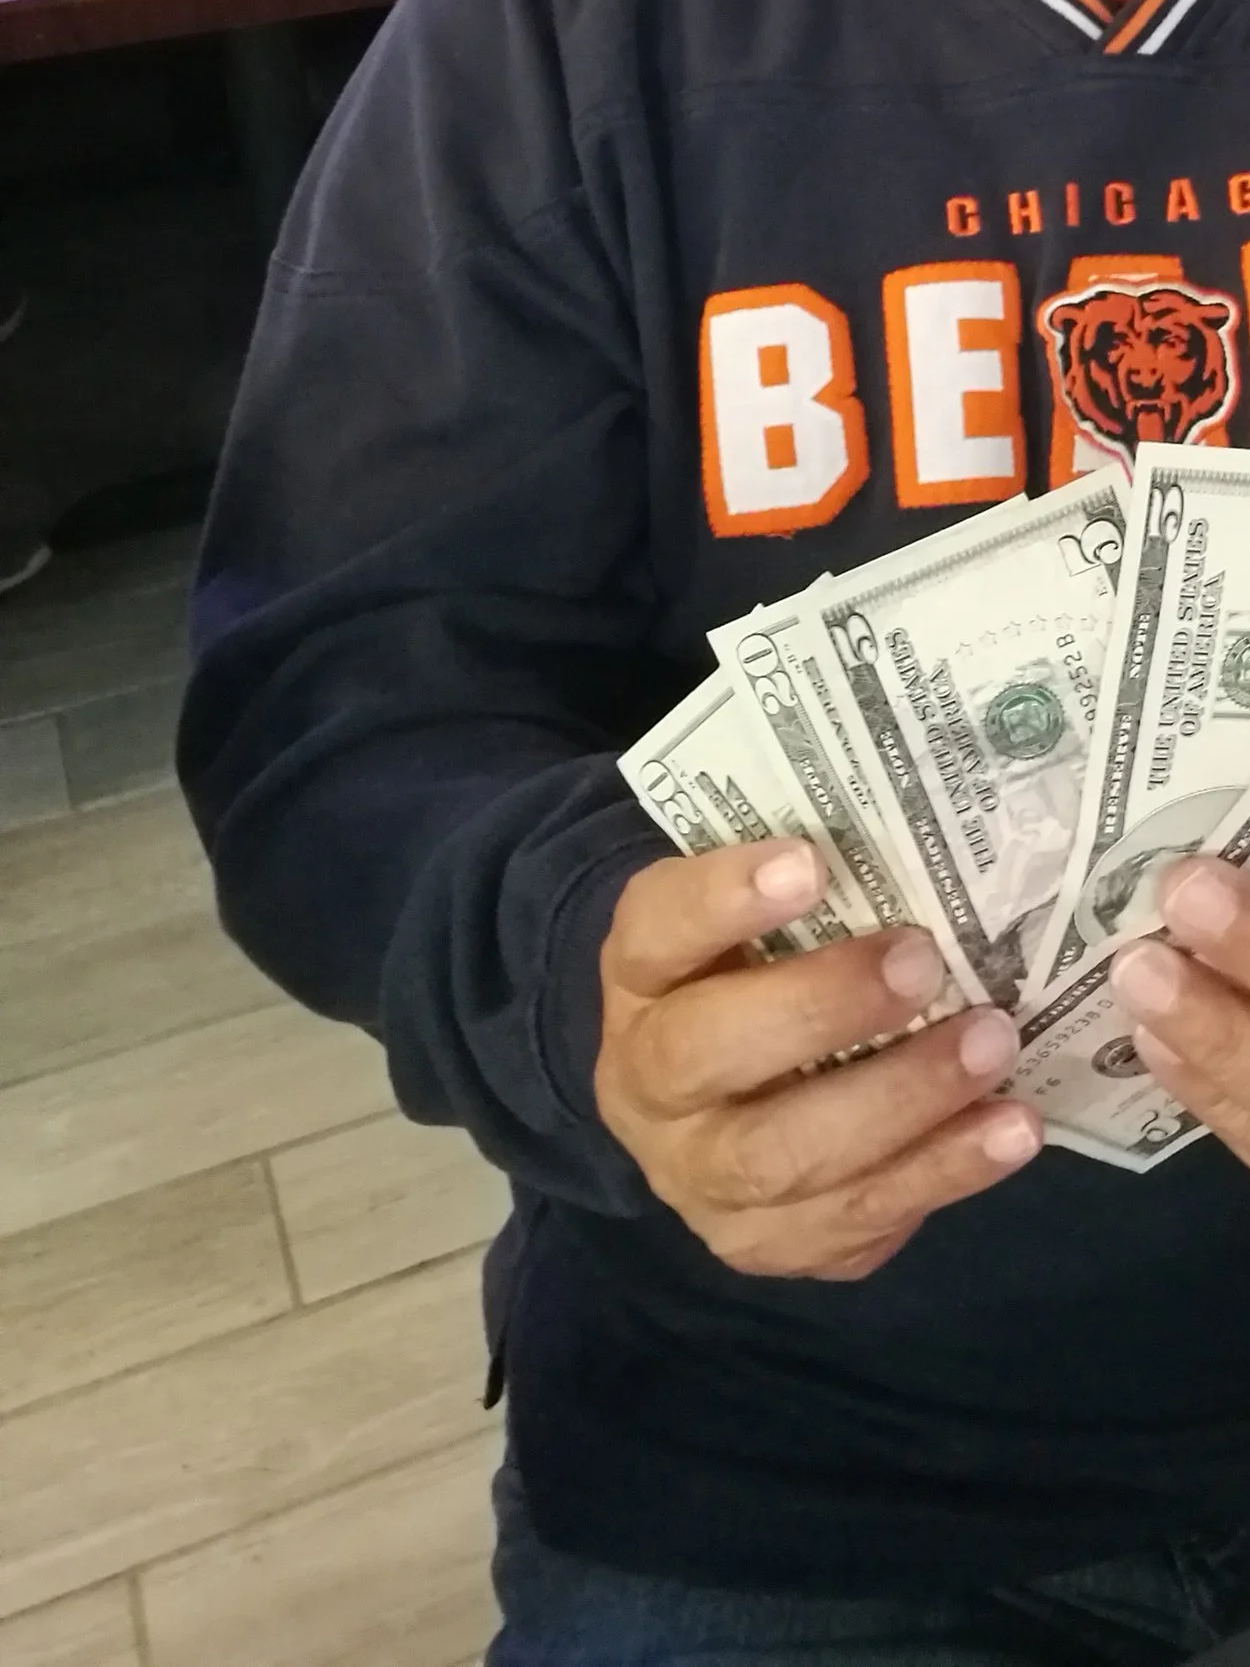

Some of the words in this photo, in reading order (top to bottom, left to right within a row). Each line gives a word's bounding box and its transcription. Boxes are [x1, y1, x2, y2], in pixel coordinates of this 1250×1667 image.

[1059, 518, 1122, 575] 5
[1149, 484, 1185, 544] 5
[1175, 515, 1208, 621] STATES
[828, 611, 878, 669] 5
[1055, 631, 1074, 648] B
[1188, 566, 1223, 698] AMERICA
[736, 632, 799, 716] 20
[882, 626, 937, 724] STATES
[1159, 627, 1192, 730] UNITED
[923, 656, 989, 780] AMERICA
[1101, 713, 1133, 836] RESERVE
[1130, 612, 1150, 678] NOTE
[1177, 699, 1202, 739] OF
[798, 758, 837, 816] NOTE
[881, 729, 912, 789] NOTE
[920, 720, 973, 816] UNITED
[1147, 732, 1173, 793] THE
[639, 759, 700, 835] 20
[972, 775, 1001, 815] OF
[916, 815, 968, 925] RESERVE
[960, 815, 997, 873] THE
